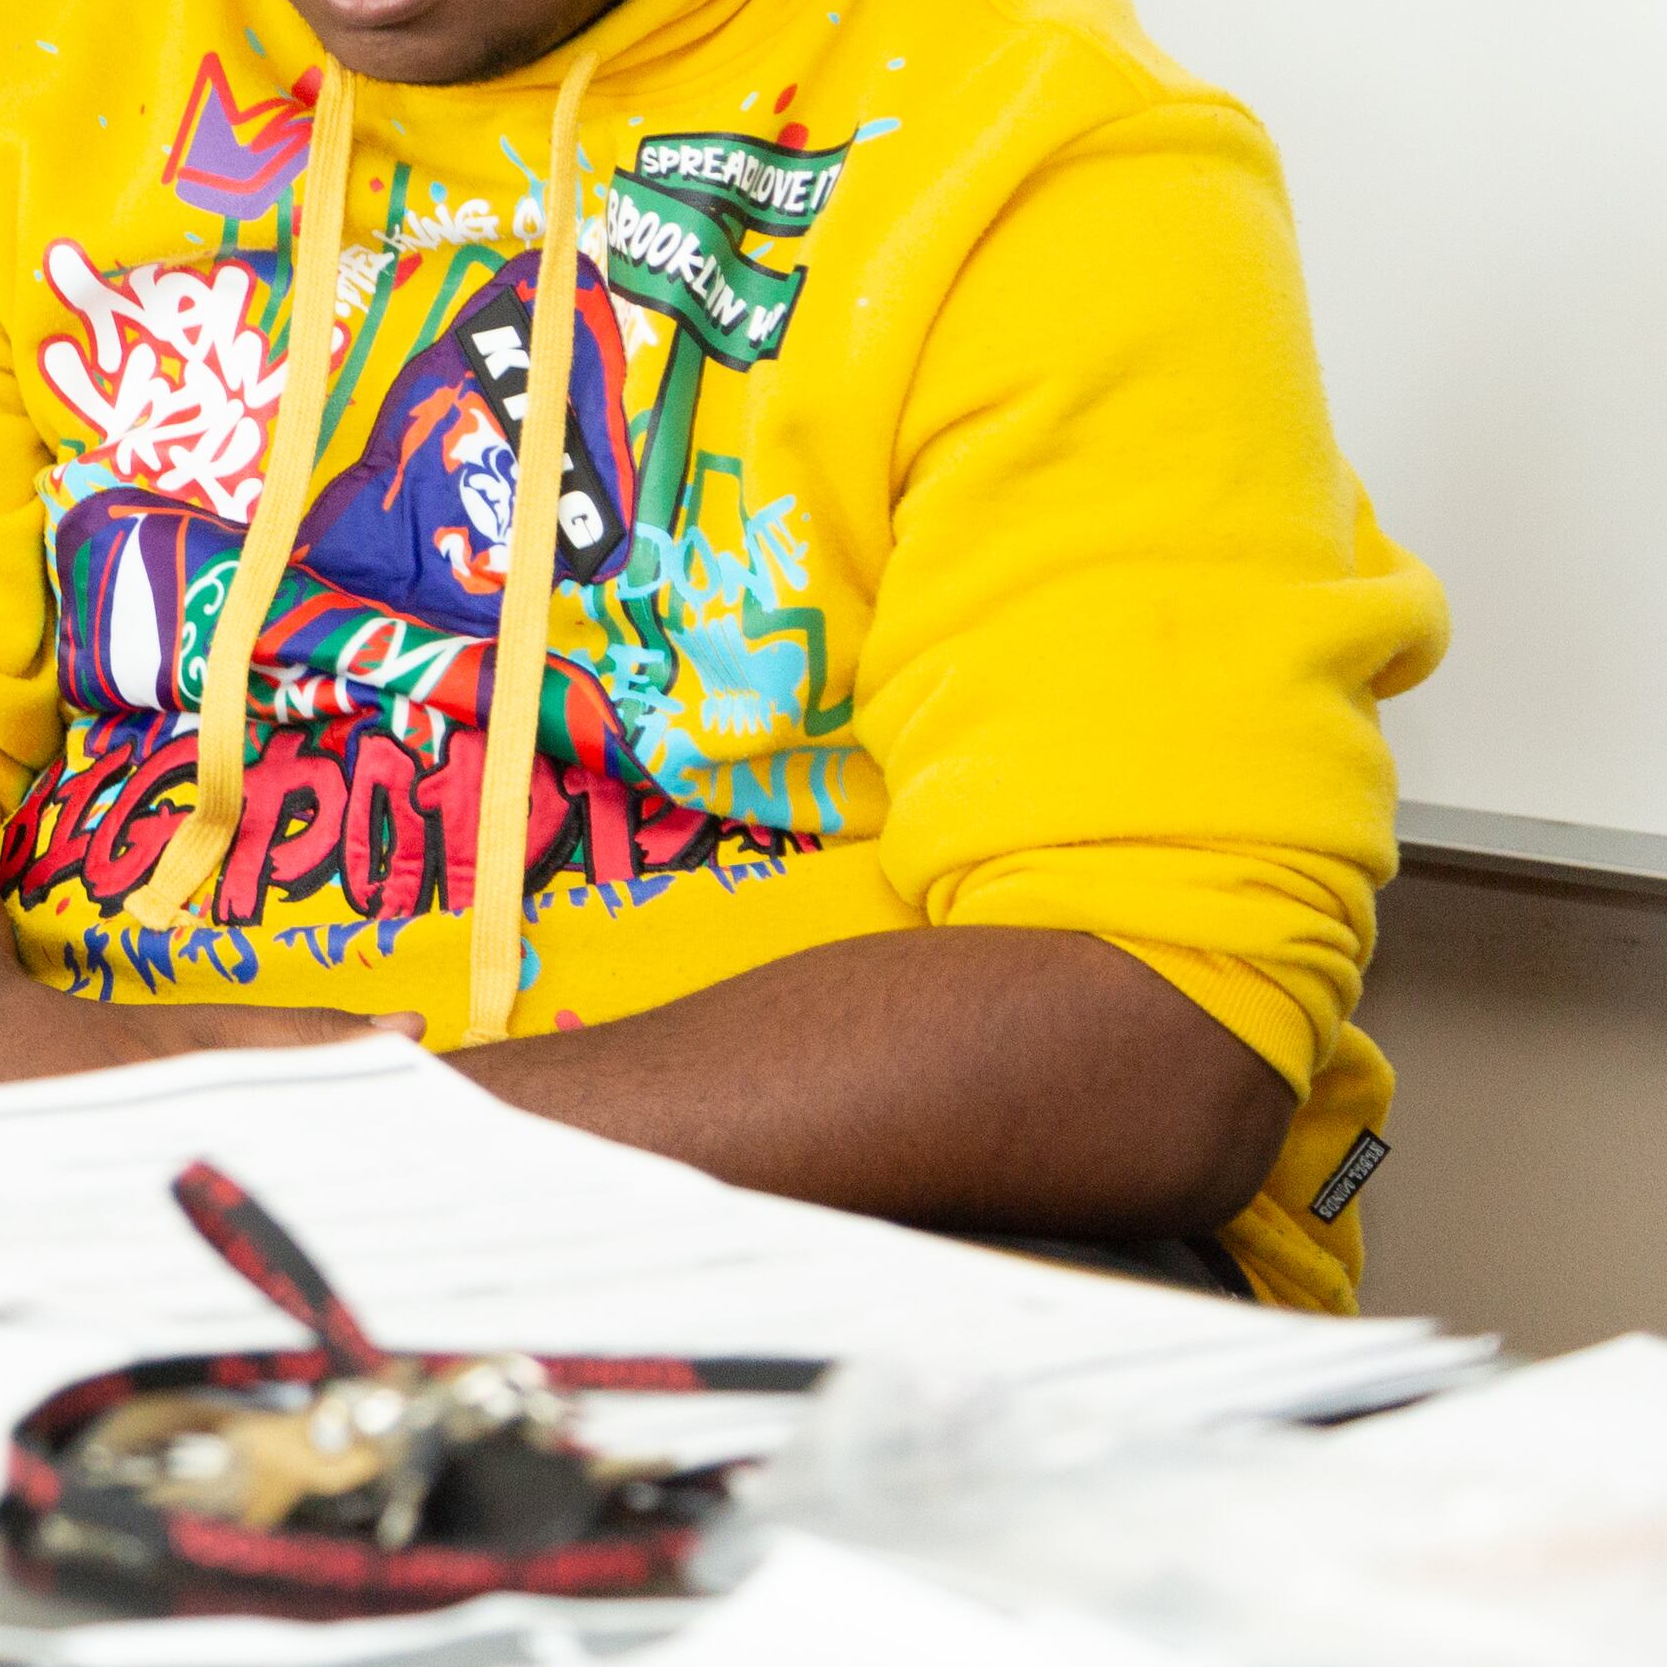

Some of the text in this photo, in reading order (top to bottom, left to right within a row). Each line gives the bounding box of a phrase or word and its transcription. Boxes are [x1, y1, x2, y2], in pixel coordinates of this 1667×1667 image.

[750, 162, 814, 212] LOVE
[371, 198, 500, 252] KING
[607, 189, 747, 327] BROOKLYN
